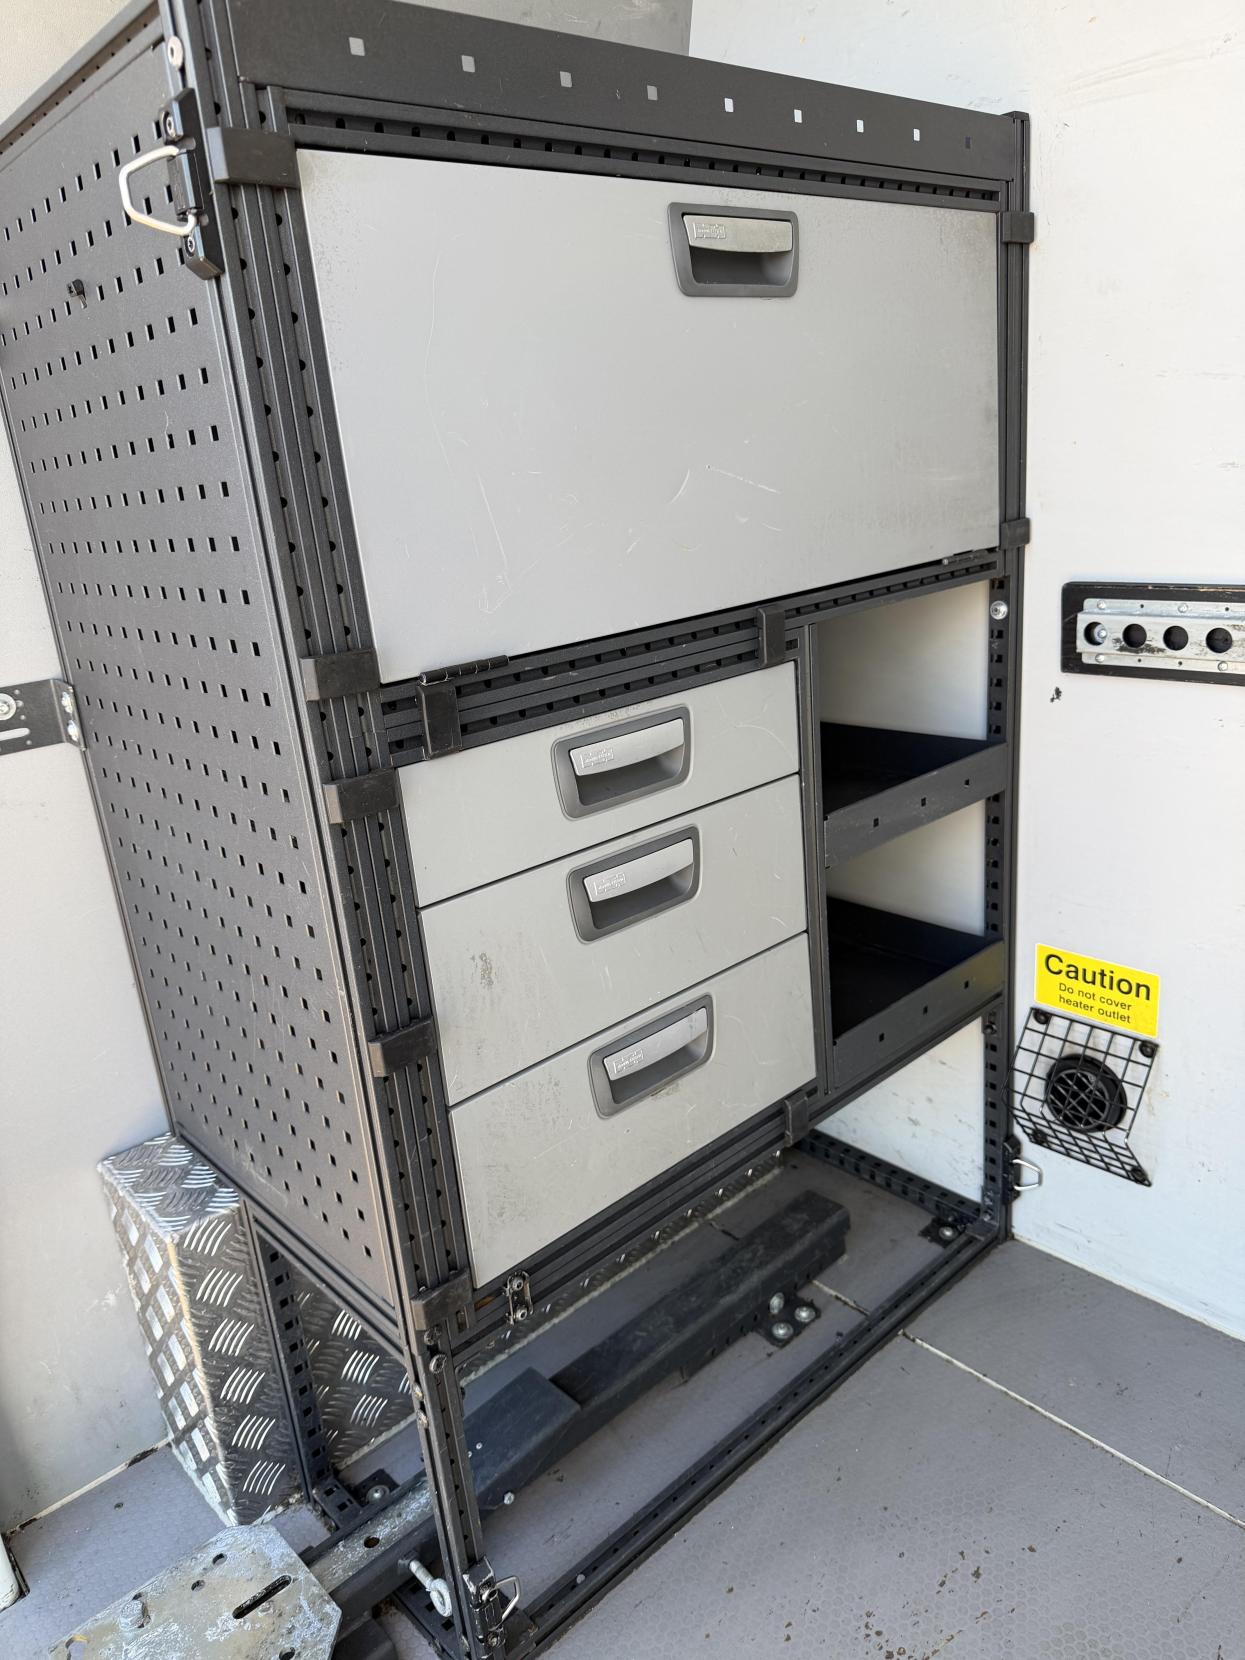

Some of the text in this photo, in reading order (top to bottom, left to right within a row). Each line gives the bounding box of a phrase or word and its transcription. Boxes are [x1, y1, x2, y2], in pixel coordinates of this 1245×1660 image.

[1044, 953, 1151, 1001] Caution
[1058, 982, 1132, 1011] Do not cover
[1058, 994, 1131, 1024] heater outlet
